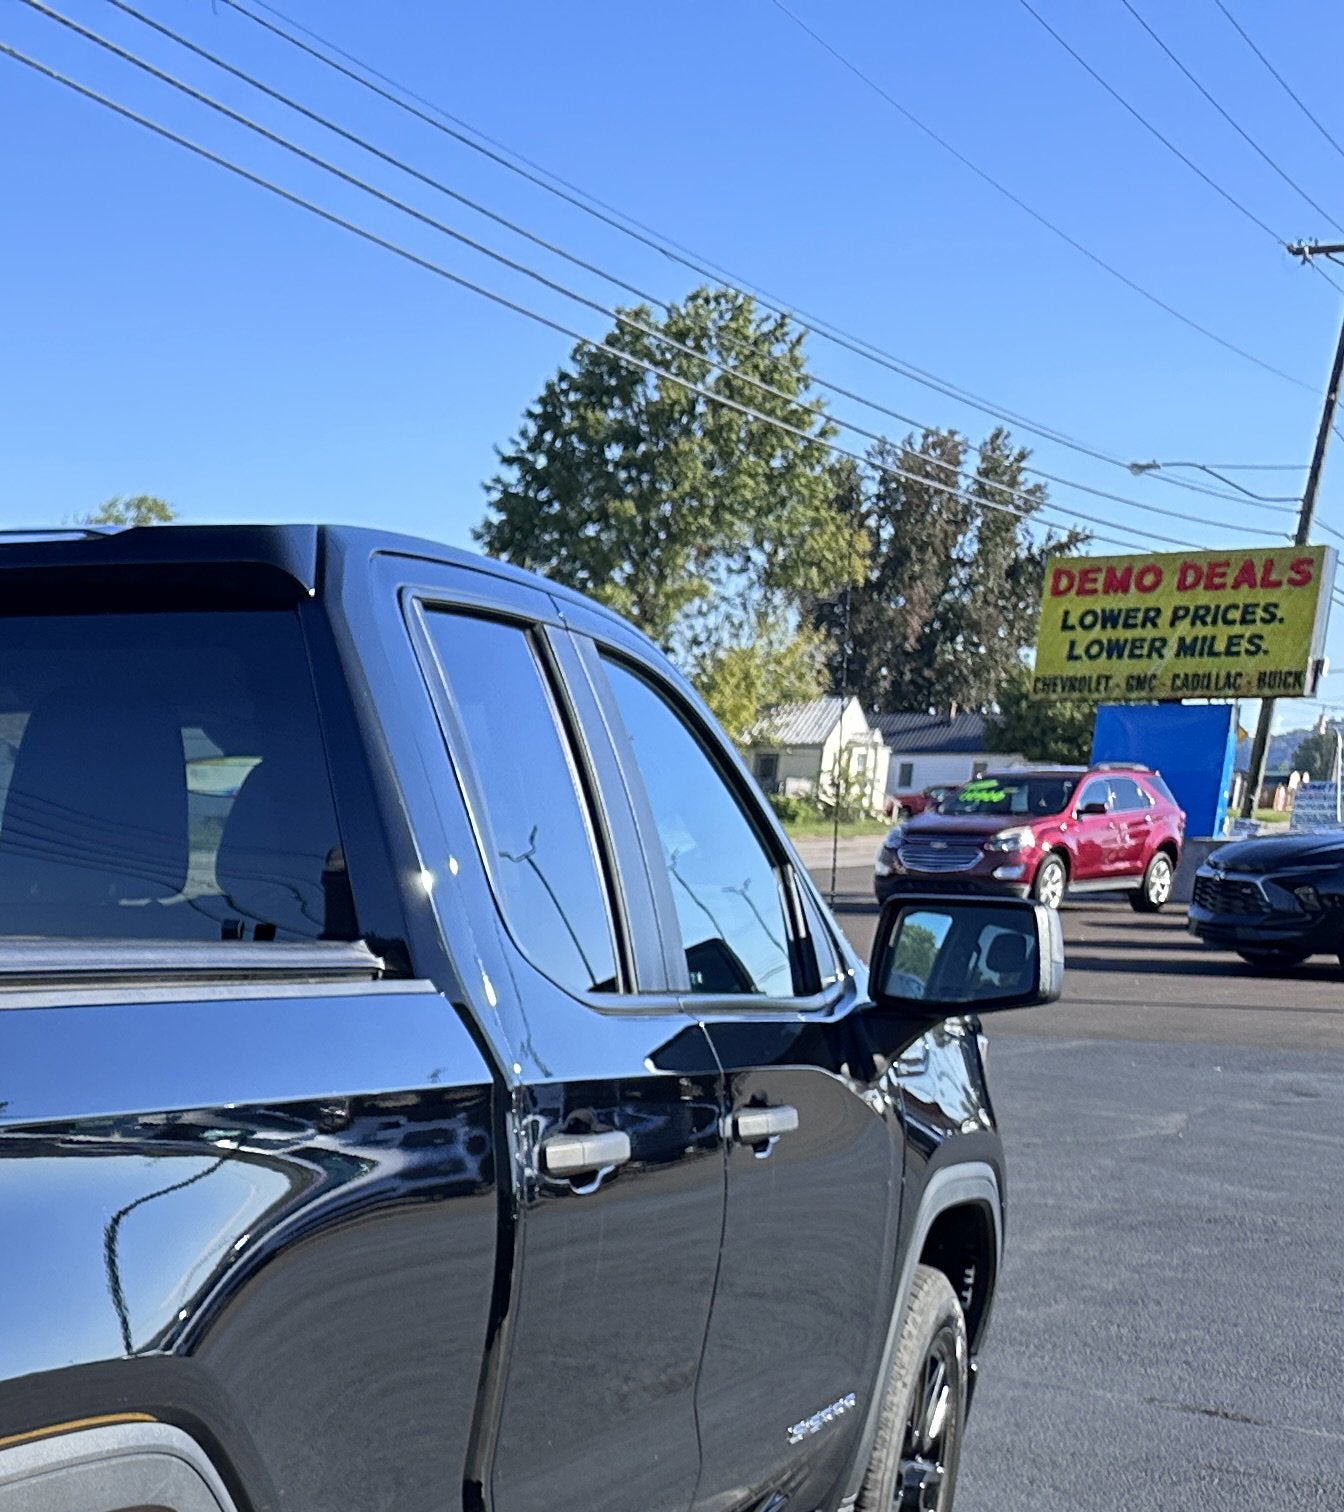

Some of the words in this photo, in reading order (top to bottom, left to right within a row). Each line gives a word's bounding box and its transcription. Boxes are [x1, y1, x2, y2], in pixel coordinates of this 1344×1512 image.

[1050, 563, 1163, 598] DEMO
[1176, 556, 1316, 593] DEALS
[1060, 606, 1162, 633] LOWER
[1169, 601, 1286, 628] PRICES.
[1066, 636, 1169, 662] LOWER
[1175, 633, 1270, 659] MILES.
[1033, 673, 1113, 695] CHEVROLET
[1125, 672, 1158, 693] GMC
[1170, 671, 1243, 693] CADILLAC
[1255, 670, 1304, 691] BUICK
